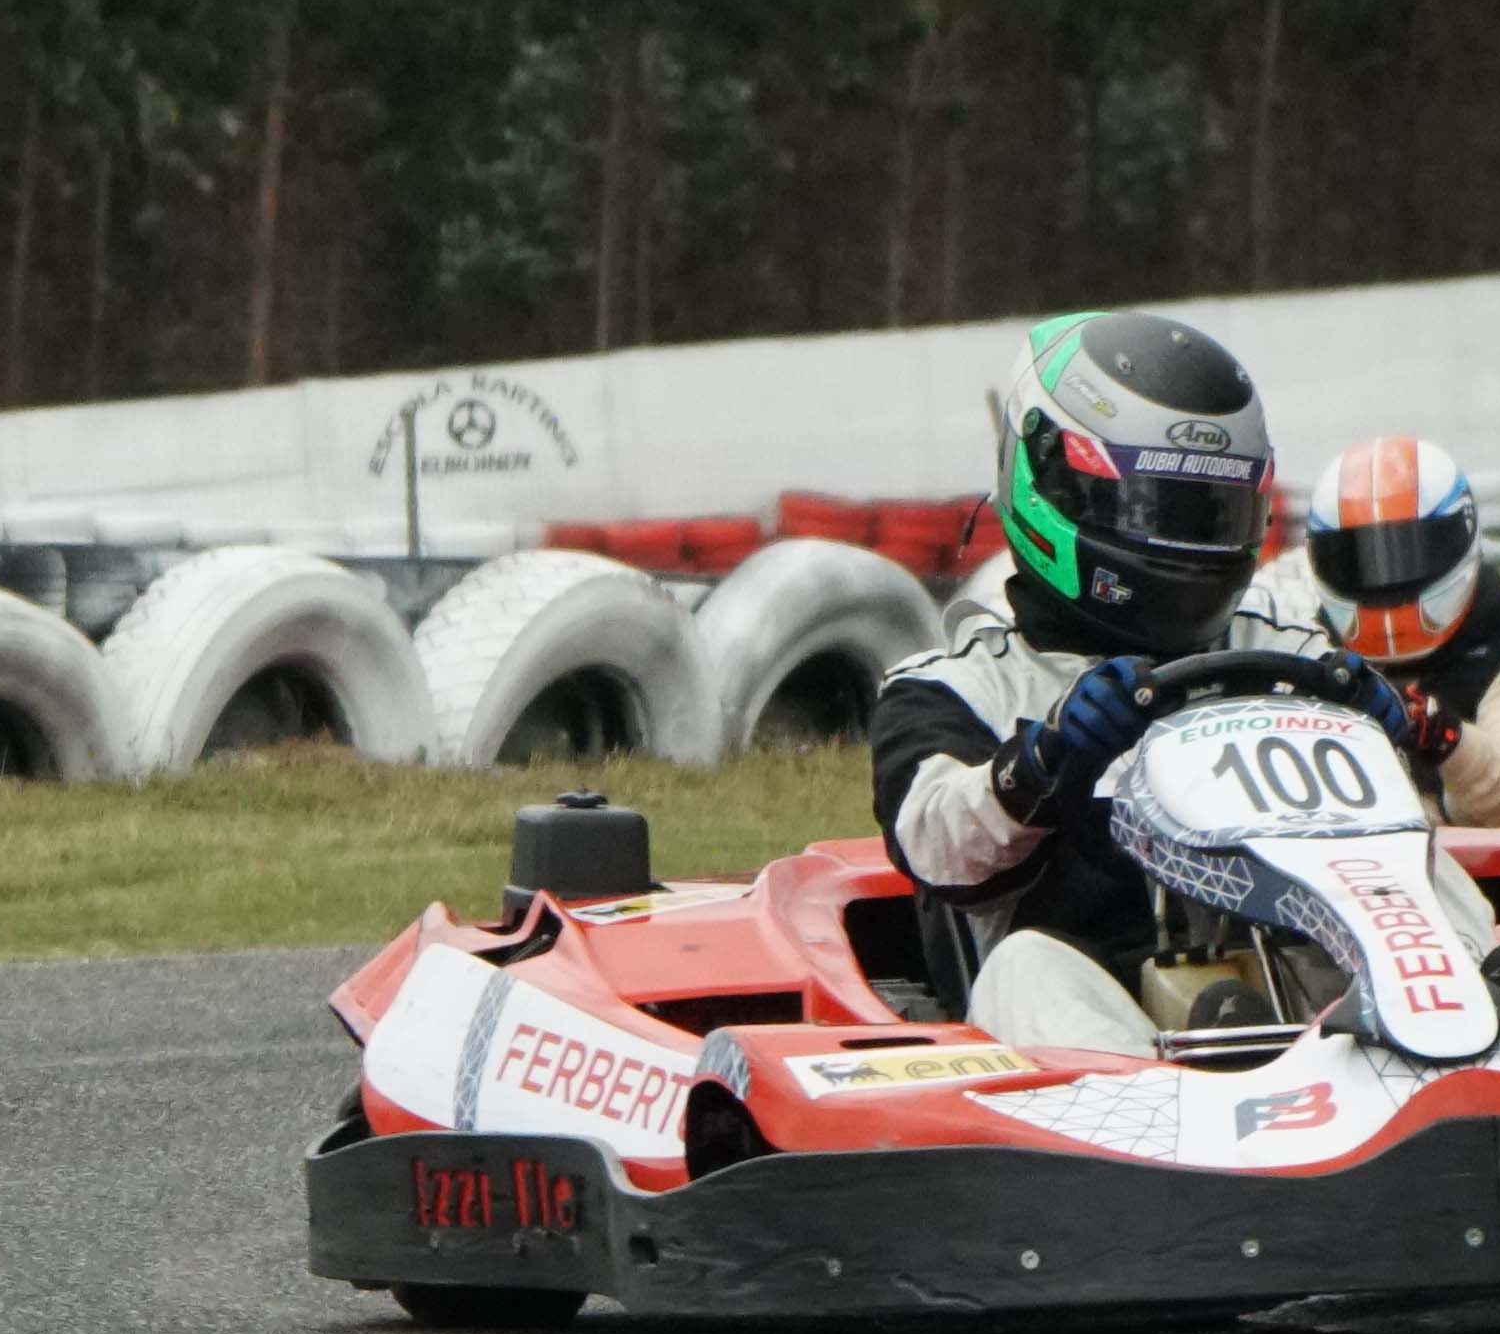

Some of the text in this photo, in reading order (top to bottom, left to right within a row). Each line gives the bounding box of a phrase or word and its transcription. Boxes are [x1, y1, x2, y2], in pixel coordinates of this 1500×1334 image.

[1172, 423, 1225, 447] Arai
[1134, 450, 1254, 481] DUBAI AUTODROME
[1179, 714, 1354, 746] EUROINDY
[1210, 735, 1378, 815] 100
[1326, 857, 1466, 1015] FERBERTO
